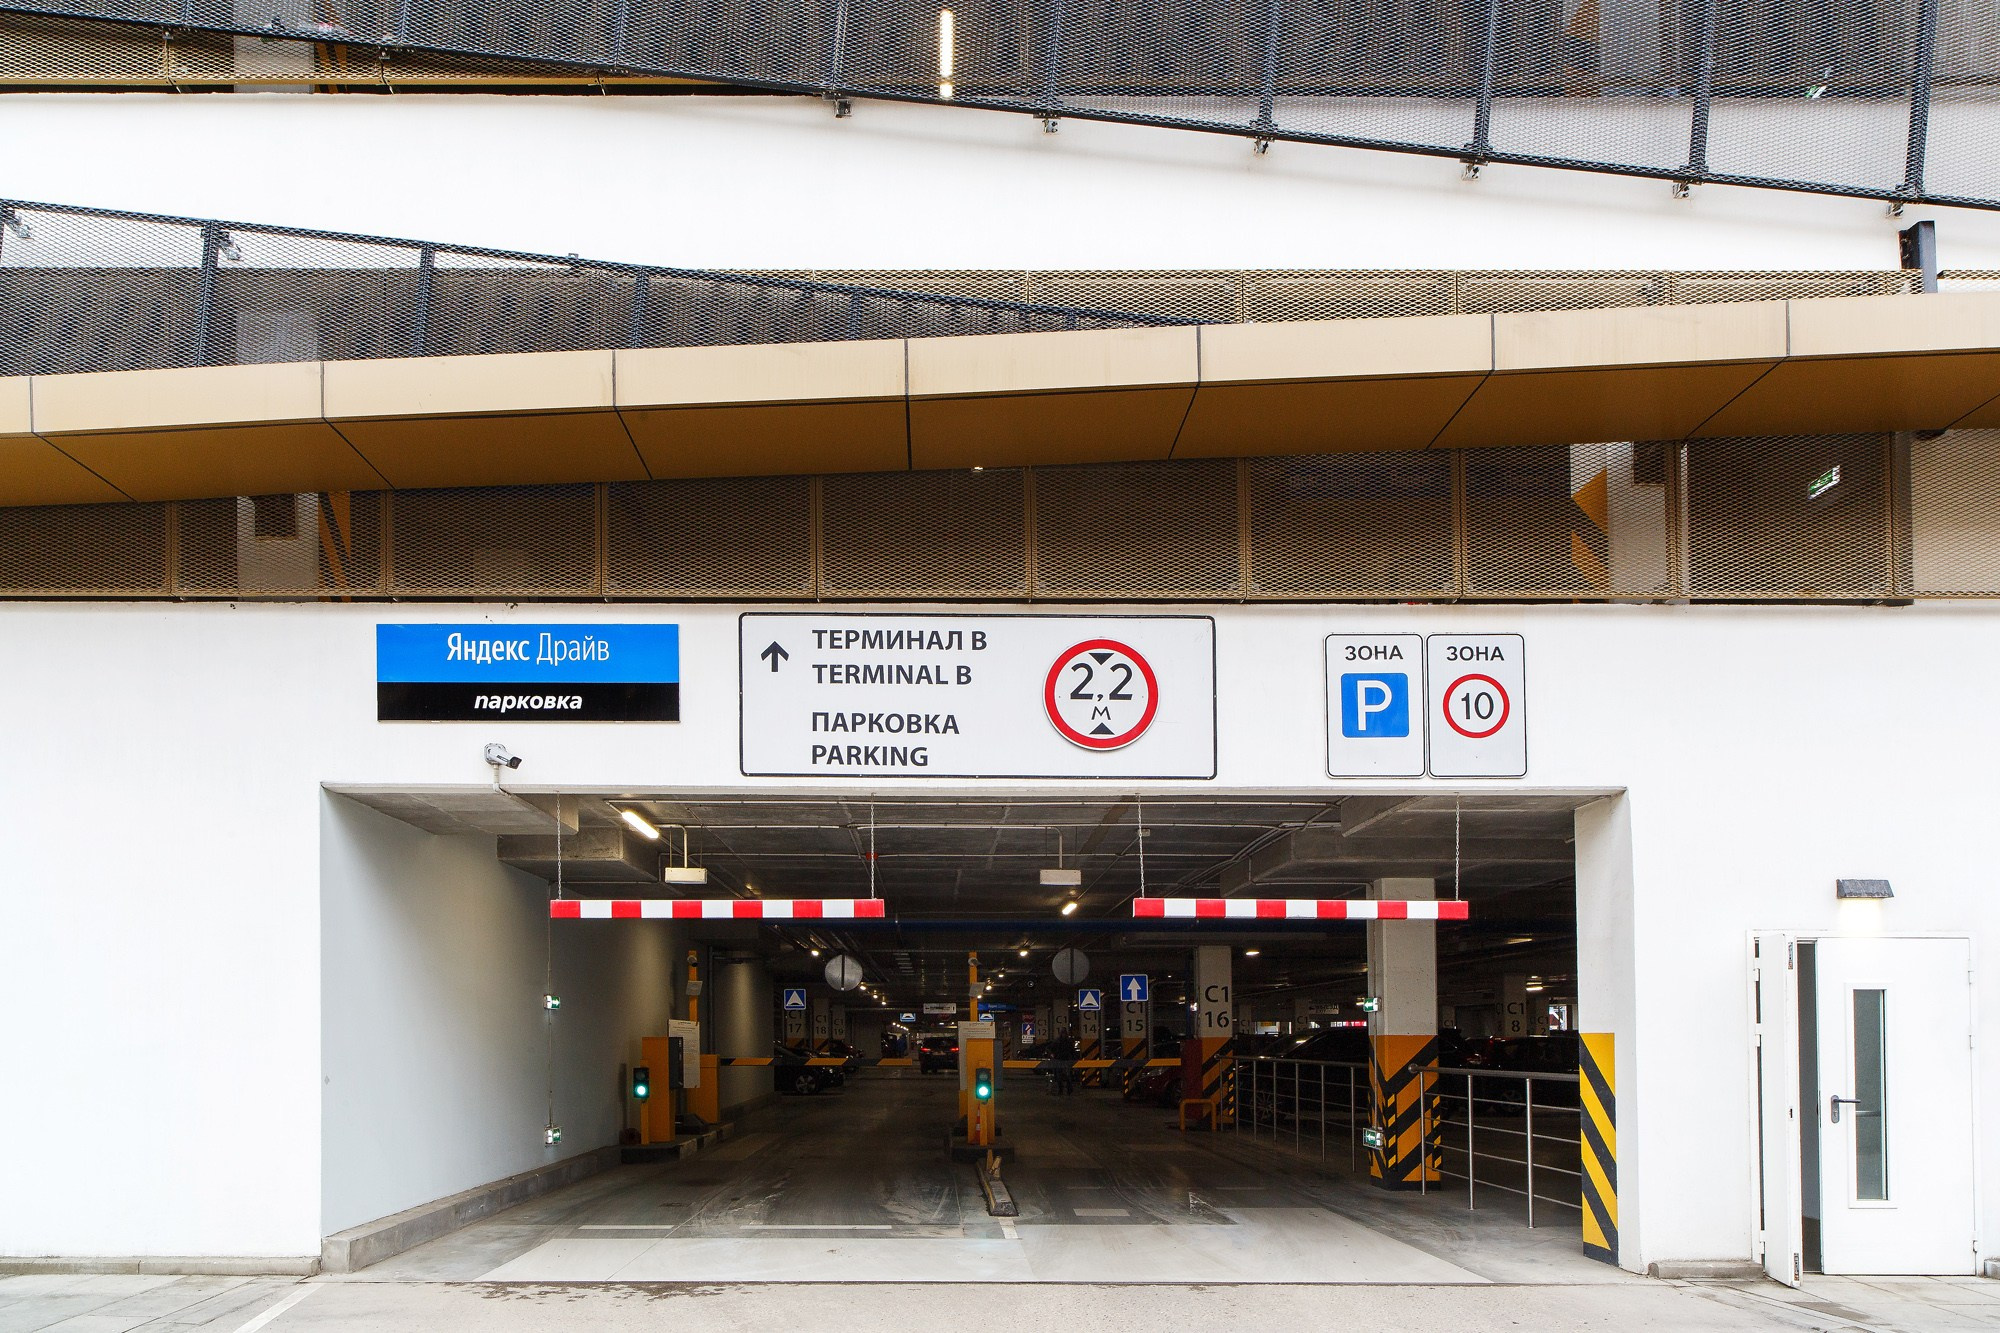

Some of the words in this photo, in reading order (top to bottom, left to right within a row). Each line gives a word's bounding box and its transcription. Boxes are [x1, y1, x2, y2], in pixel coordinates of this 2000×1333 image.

[446, 632, 531, 664] Яндекс
[536, 632, 610, 667] Драйв
[812, 630, 962, 651] ТЕРМИНАЛ
[1345, 645, 1403, 661] ЗОНА
[1446, 646, 1504, 661] ЗОНА
[812, 665, 948, 685] TERMINAL
[956, 666, 972, 685] B
[1070, 662, 1133, 702] 2,2
[474, 695, 583, 713] парковка
[1357, 680, 1393, 731] P
[1461, 692, 1494, 720] 10
[812, 712, 960, 735] ПАРКОВКА
[812, 745, 928, 767] PARKING
[789, 1023, 802, 1033] 17
[1127, 1019, 1144, 1032] 15
[1205, 1011, 1229, 1028] 16
[1511, 1020, 1520, 1033] 8
[816, 1026, 827, 1035] 18
[1083, 1024, 1097, 1034] 14
